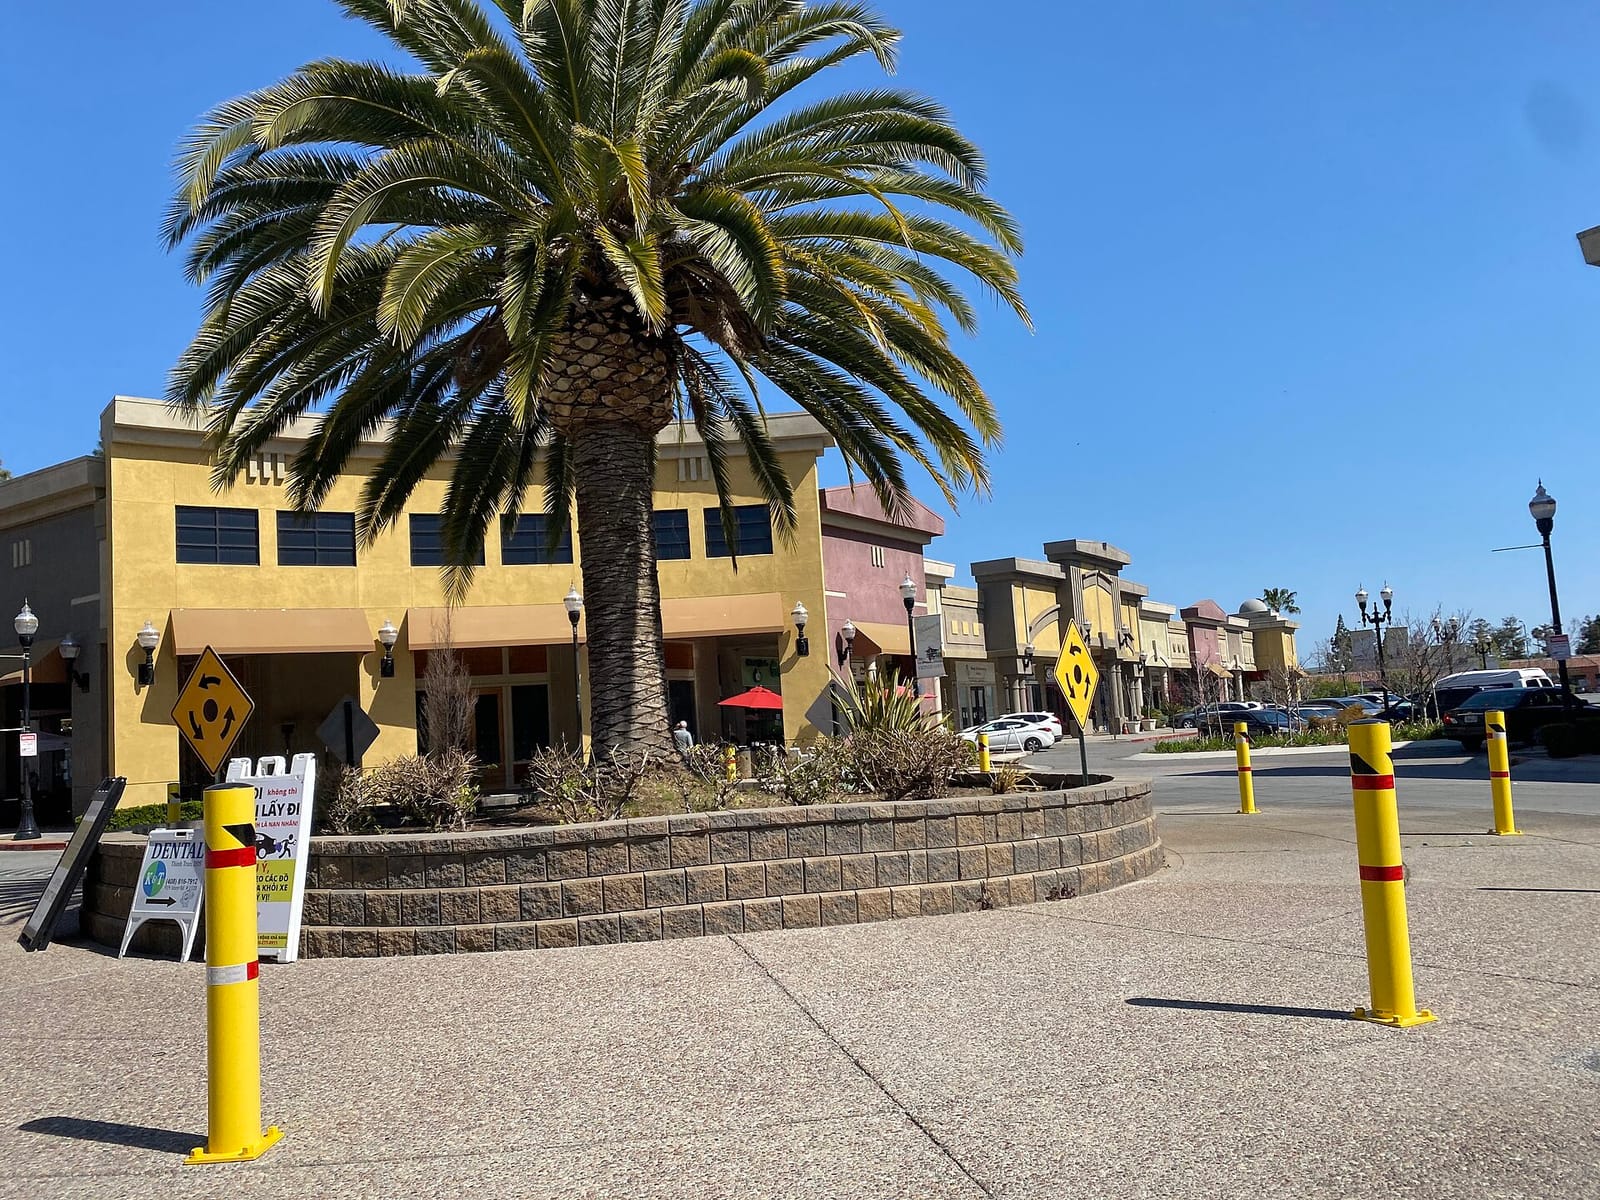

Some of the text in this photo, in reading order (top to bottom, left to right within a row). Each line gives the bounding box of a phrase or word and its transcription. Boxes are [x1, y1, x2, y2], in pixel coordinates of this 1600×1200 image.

[262, 799, 285, 817] LẤY
[287, 803, 300, 815] ĐI
[151, 842, 204, 860] DENTAL
[264, 873, 278, 882] CÁC
[280, 884, 288, 892] XE
